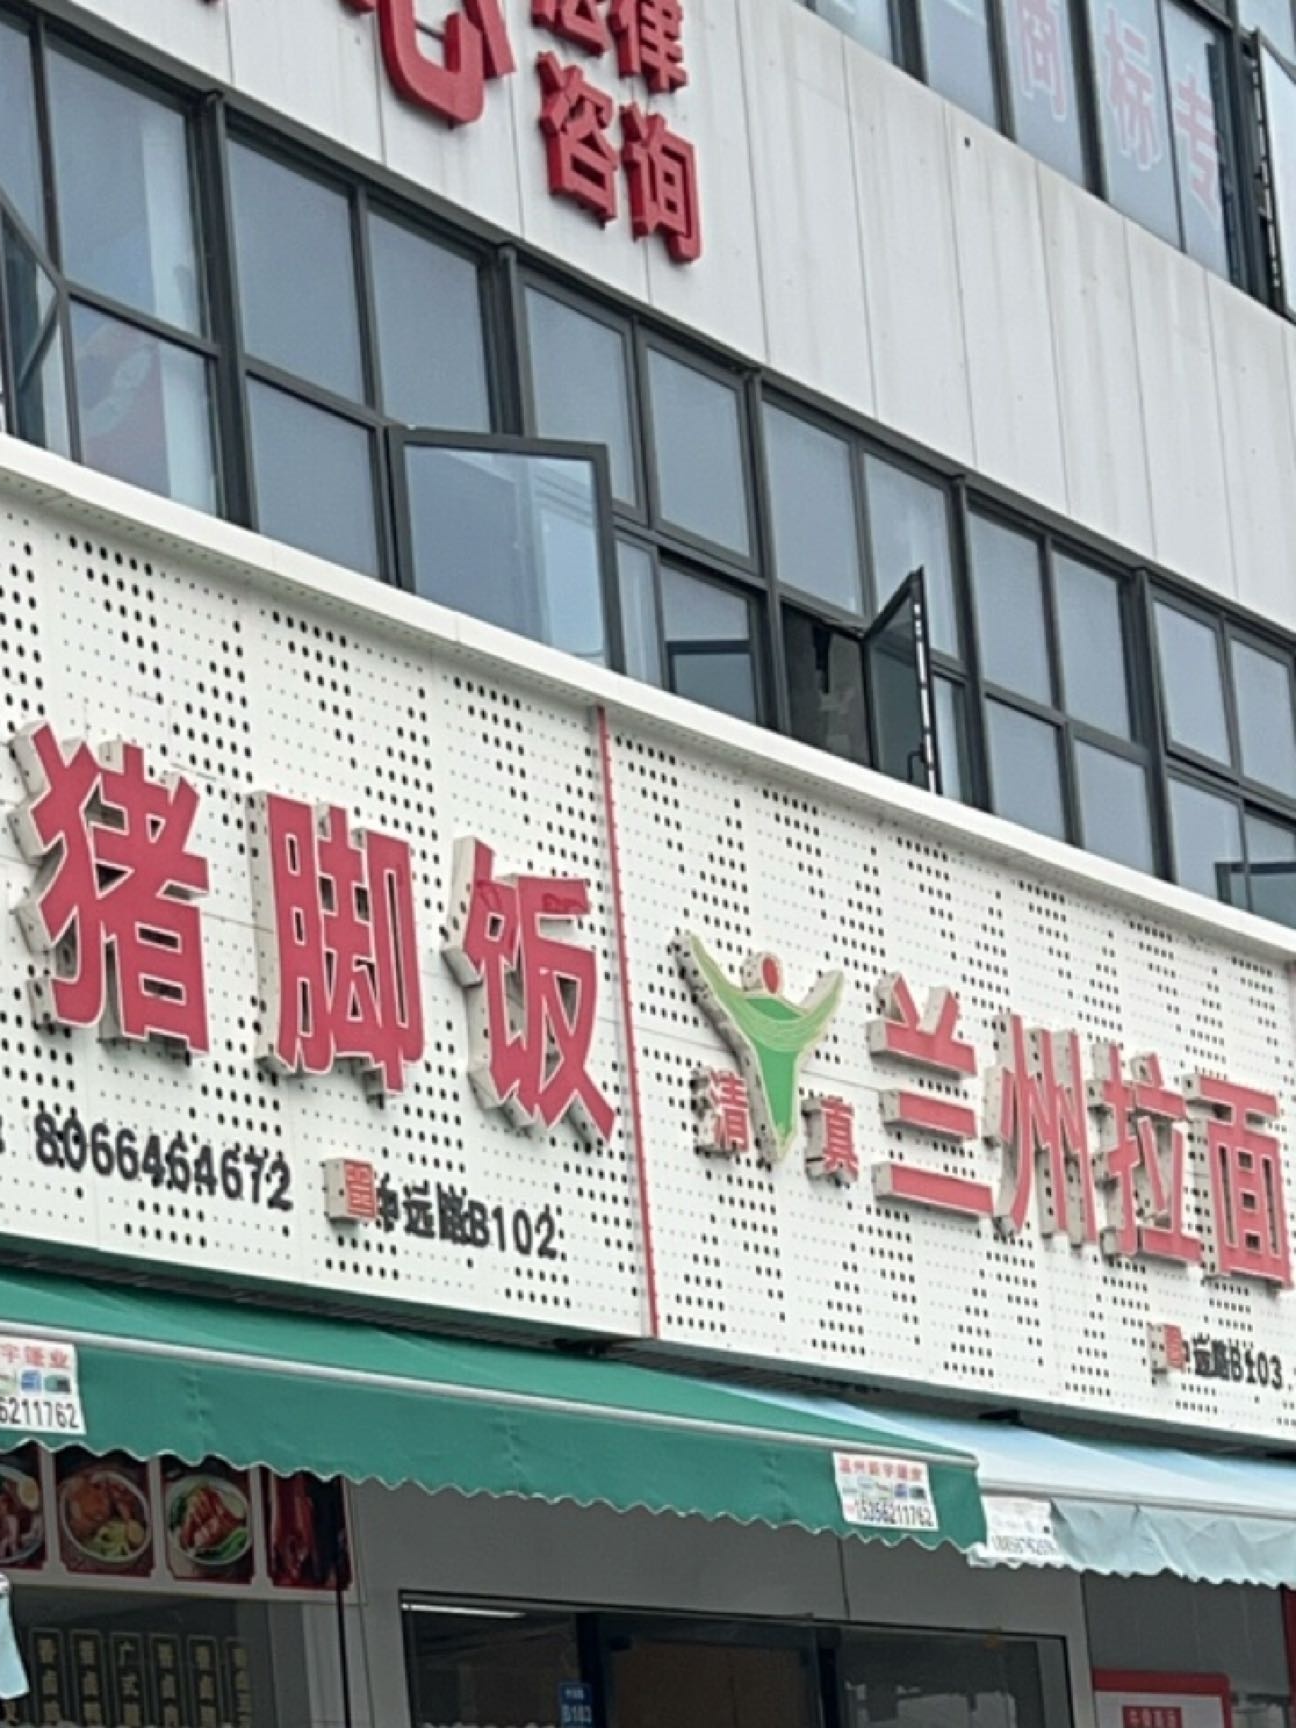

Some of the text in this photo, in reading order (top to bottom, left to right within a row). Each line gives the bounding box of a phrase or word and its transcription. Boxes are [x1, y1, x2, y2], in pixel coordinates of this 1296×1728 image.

[536, 52, 701, 263] 咨询
[876, 973, 1291, 1288] 兰州拉面
